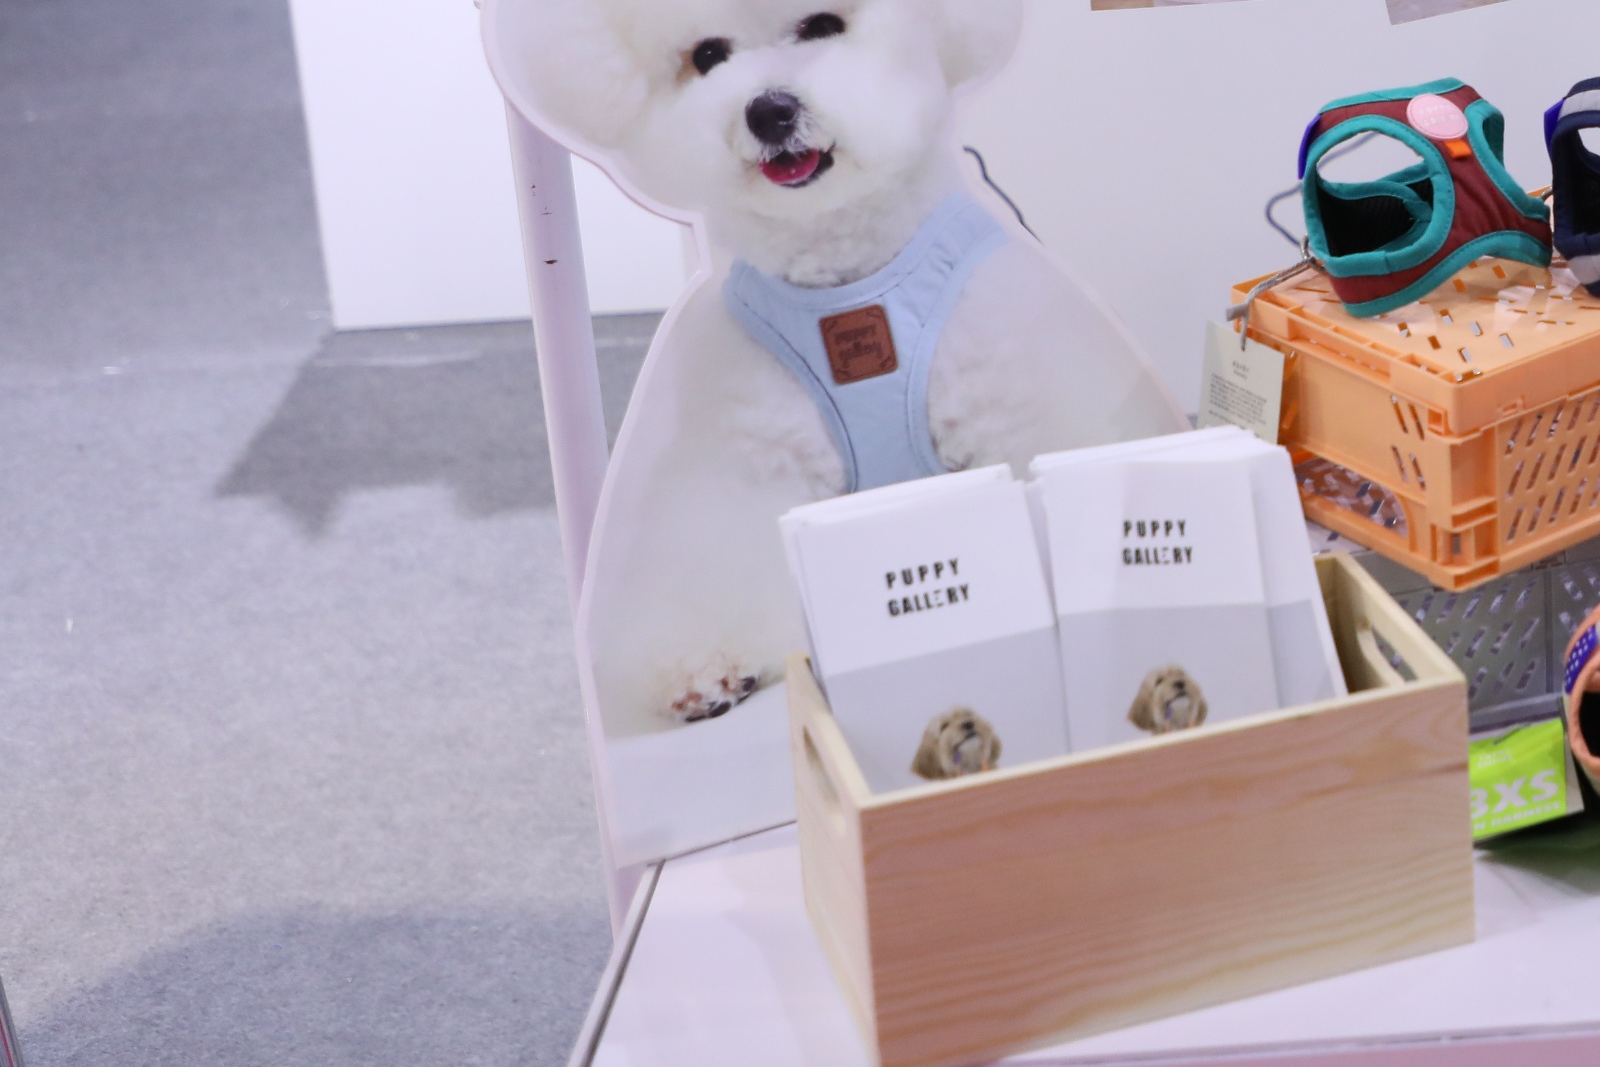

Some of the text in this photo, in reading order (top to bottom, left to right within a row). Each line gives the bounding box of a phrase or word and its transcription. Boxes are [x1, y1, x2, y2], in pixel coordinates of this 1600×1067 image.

[1122, 519, 1186, 538] PUPPY
[1122, 546, 1193, 566] GALLERY
[885, 558, 960, 589] PUPPY
[887, 583, 970, 617] GALLERY
[1470, 768, 1559, 819] 3XS
[1491, 801, 1562, 827] HARNESS
